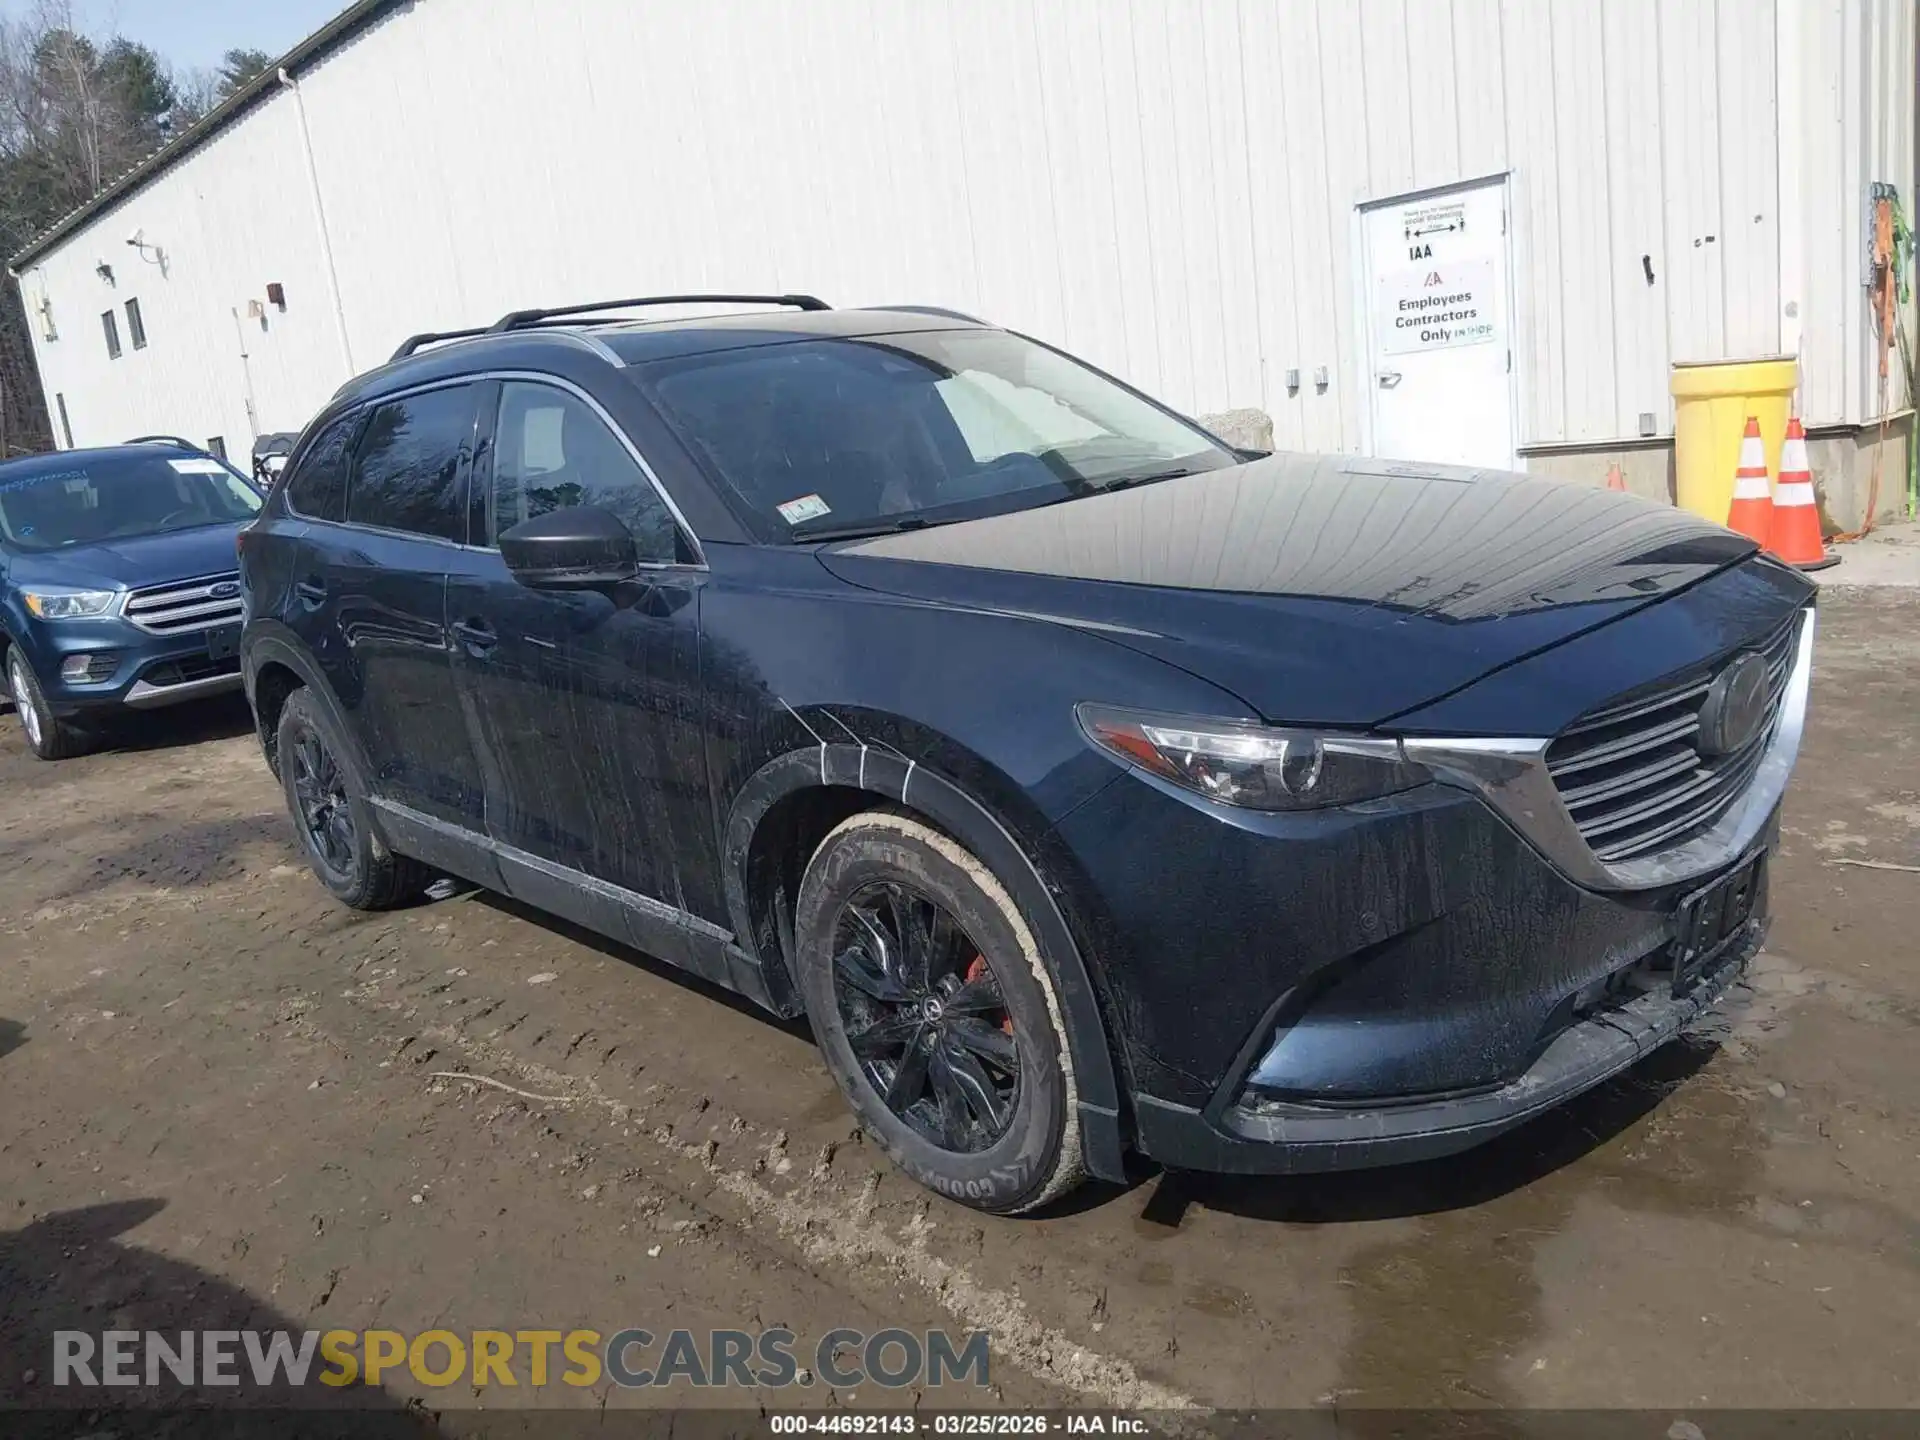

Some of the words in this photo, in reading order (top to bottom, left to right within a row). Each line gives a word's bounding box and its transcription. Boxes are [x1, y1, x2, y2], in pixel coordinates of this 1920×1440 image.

[1409, 244, 1432, 261] IAA
[1399, 292, 1472, 311] Employees
[1395, 308, 1477, 328] Contractors
[1420, 328, 1452, 343] Only
